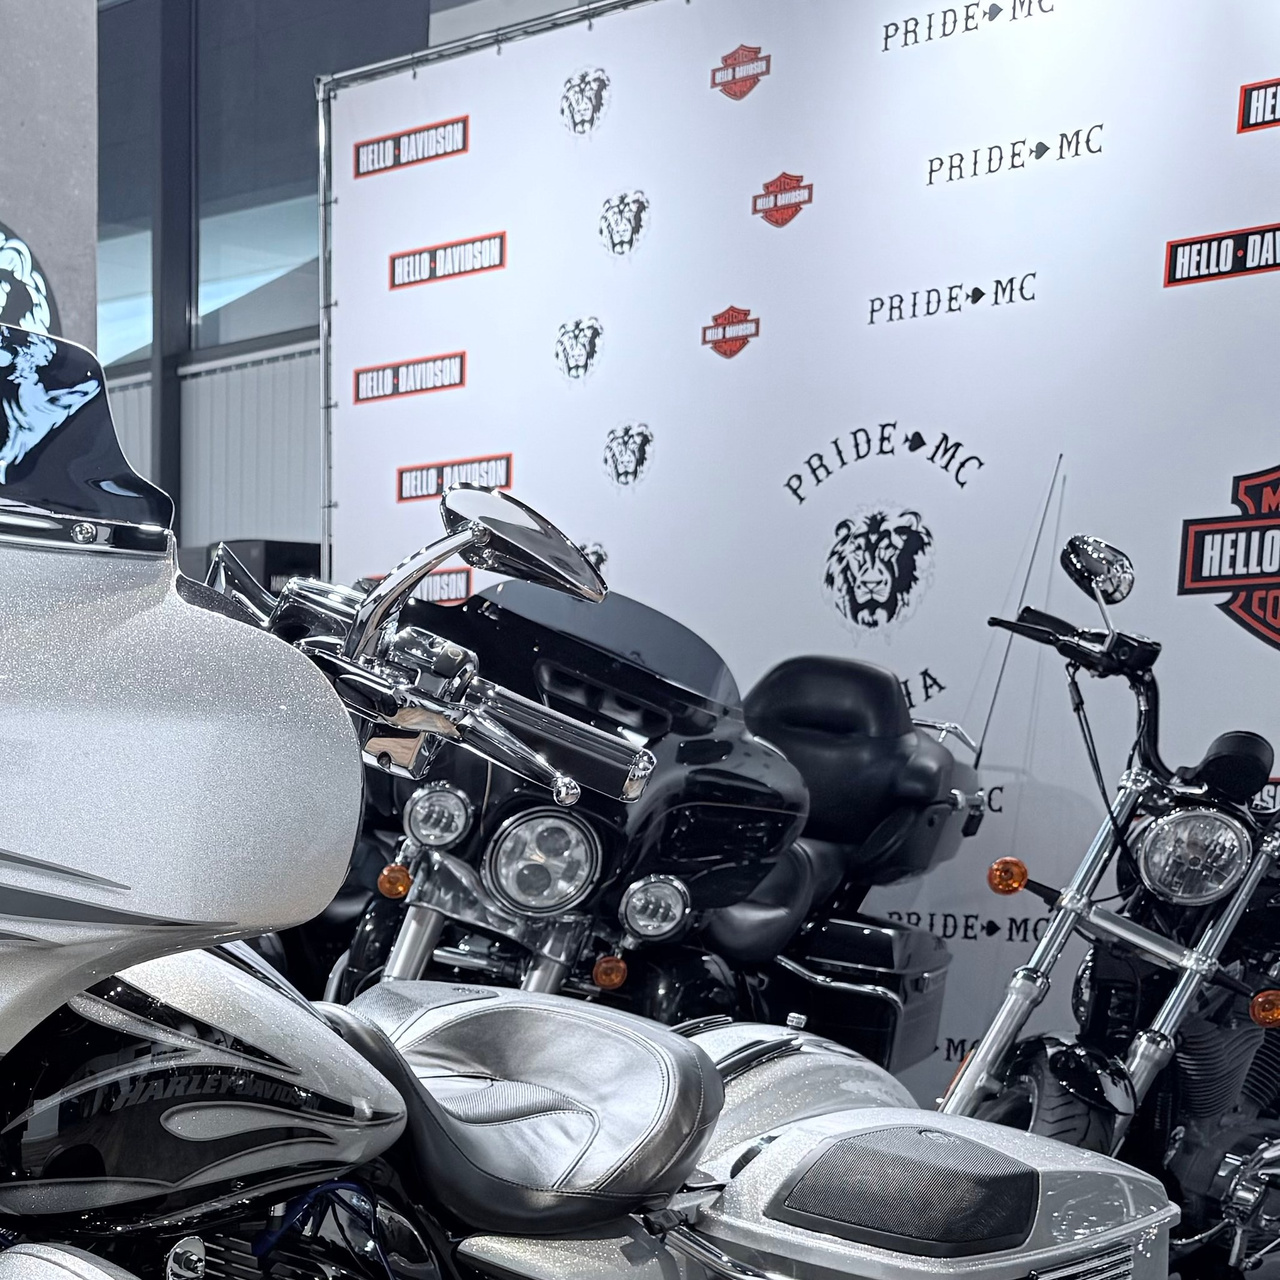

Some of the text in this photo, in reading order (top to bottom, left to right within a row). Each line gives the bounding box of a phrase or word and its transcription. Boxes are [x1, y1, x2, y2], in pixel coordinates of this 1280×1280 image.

[882, 0, 980, 52] PRIDE
[1249, 85, 1280, 124] HEL
[359, 121, 463, 174] HELLO DAVIDSON
[926, 123, 1104, 186] PRIDE MC
[394, 237, 500, 285] HELLO DAVIDSON
[1175, 239, 1234, 279] HELLO
[867, 271, 1037, 325] PRIDE MC
[358, 356, 461, 399] HELLO DAVIDSON
[402, 468, 437, 498] HELLO
[783, 421, 985, 505] PRIDE MC
[1201, 529, 1280, 577] HELLO
[413, 571, 467, 602] VIDSON
